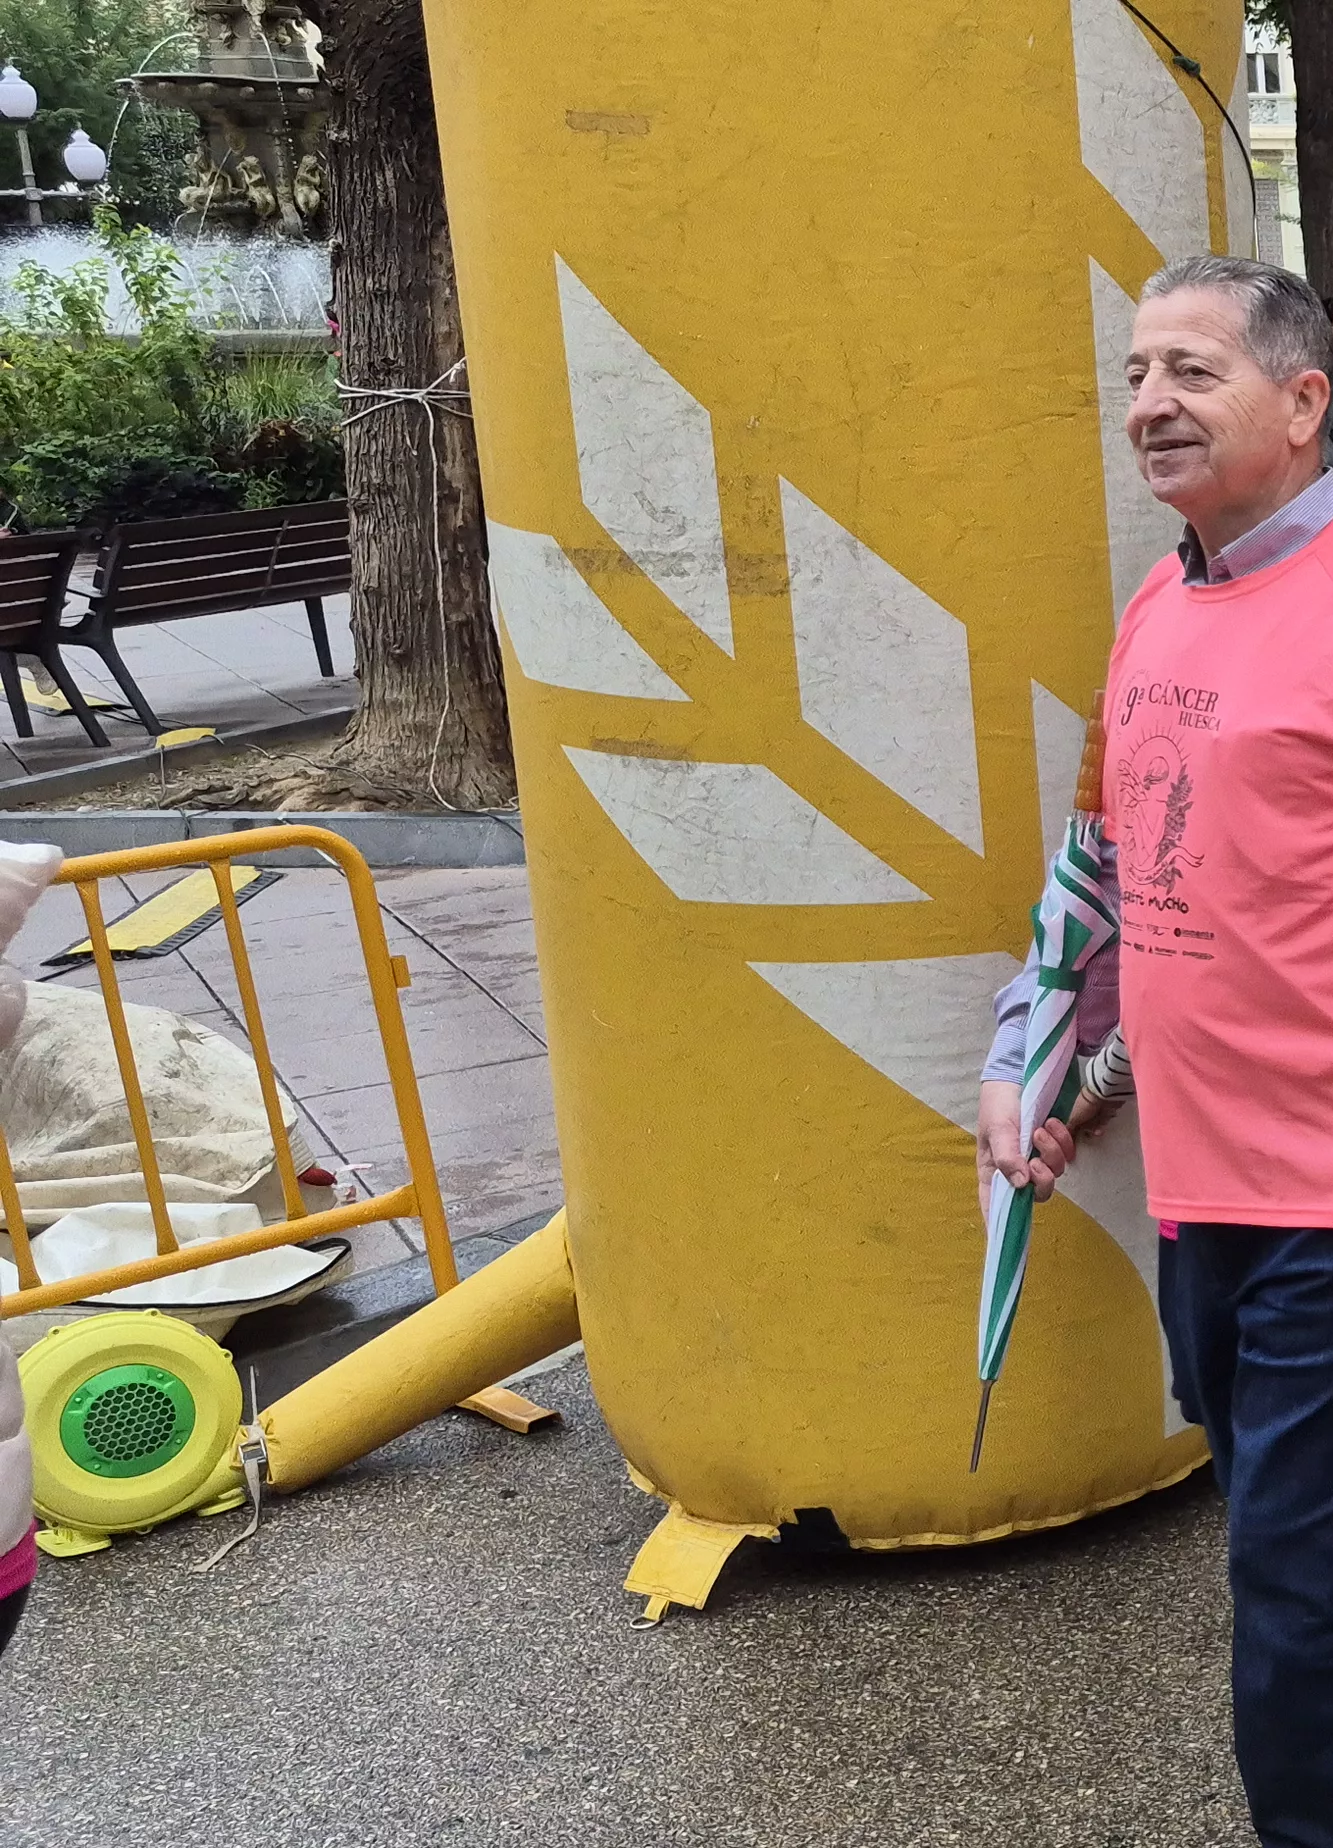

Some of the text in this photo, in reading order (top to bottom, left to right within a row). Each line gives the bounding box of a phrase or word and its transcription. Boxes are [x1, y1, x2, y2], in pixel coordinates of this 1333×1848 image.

[1148, 679, 1219, 713] CÁNCER
[1178, 710, 1221, 731] HUESCA
[1148, 896, 1190, 914] MUCHO
